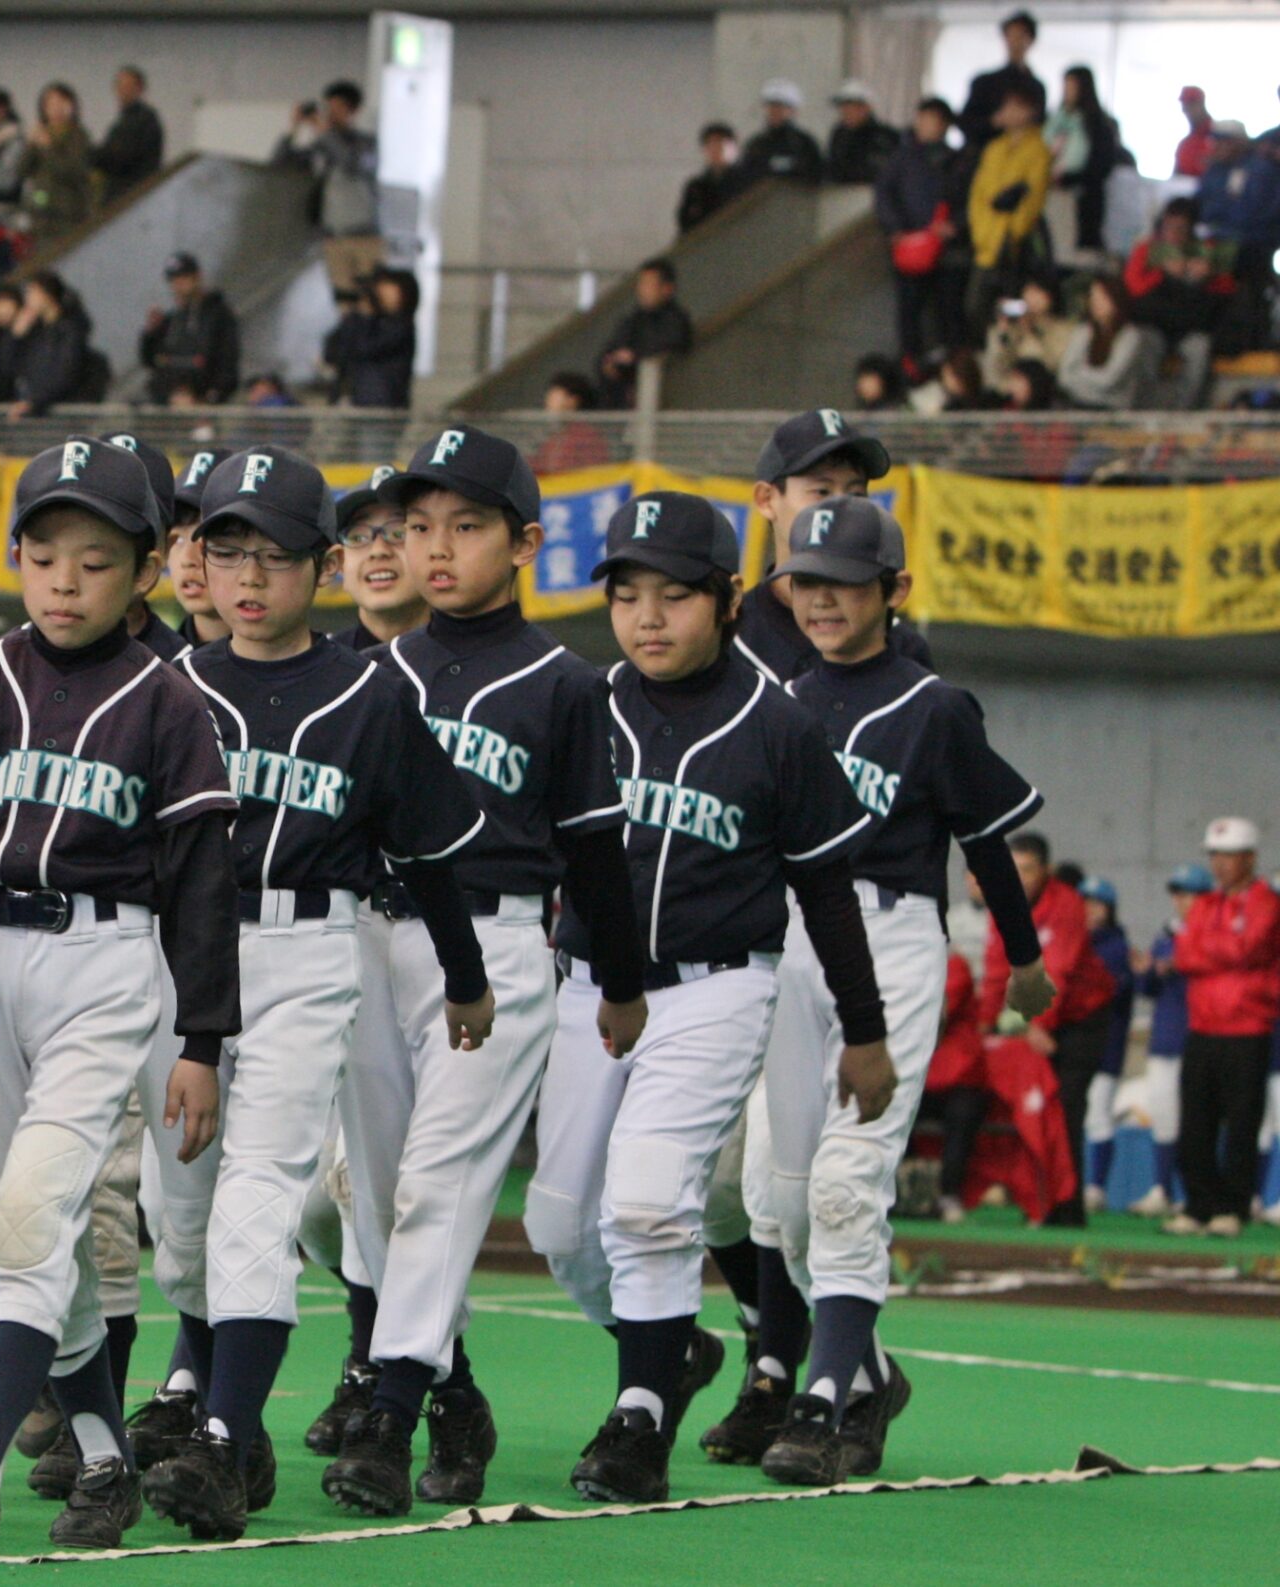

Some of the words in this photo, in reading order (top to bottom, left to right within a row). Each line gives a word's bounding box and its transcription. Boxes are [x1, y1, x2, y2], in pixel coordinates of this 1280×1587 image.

[817, 408, 843, 437] F
[57, 441, 91, 482] F
[427, 430, 465, 465] F
[184, 452, 214, 487] F
[238, 454, 273, 493] F
[632, 501, 661, 539] F
[808, 510, 834, 545] F
[423, 715, 531, 796] TERS
[616, 777, 745, 851] HTERS
